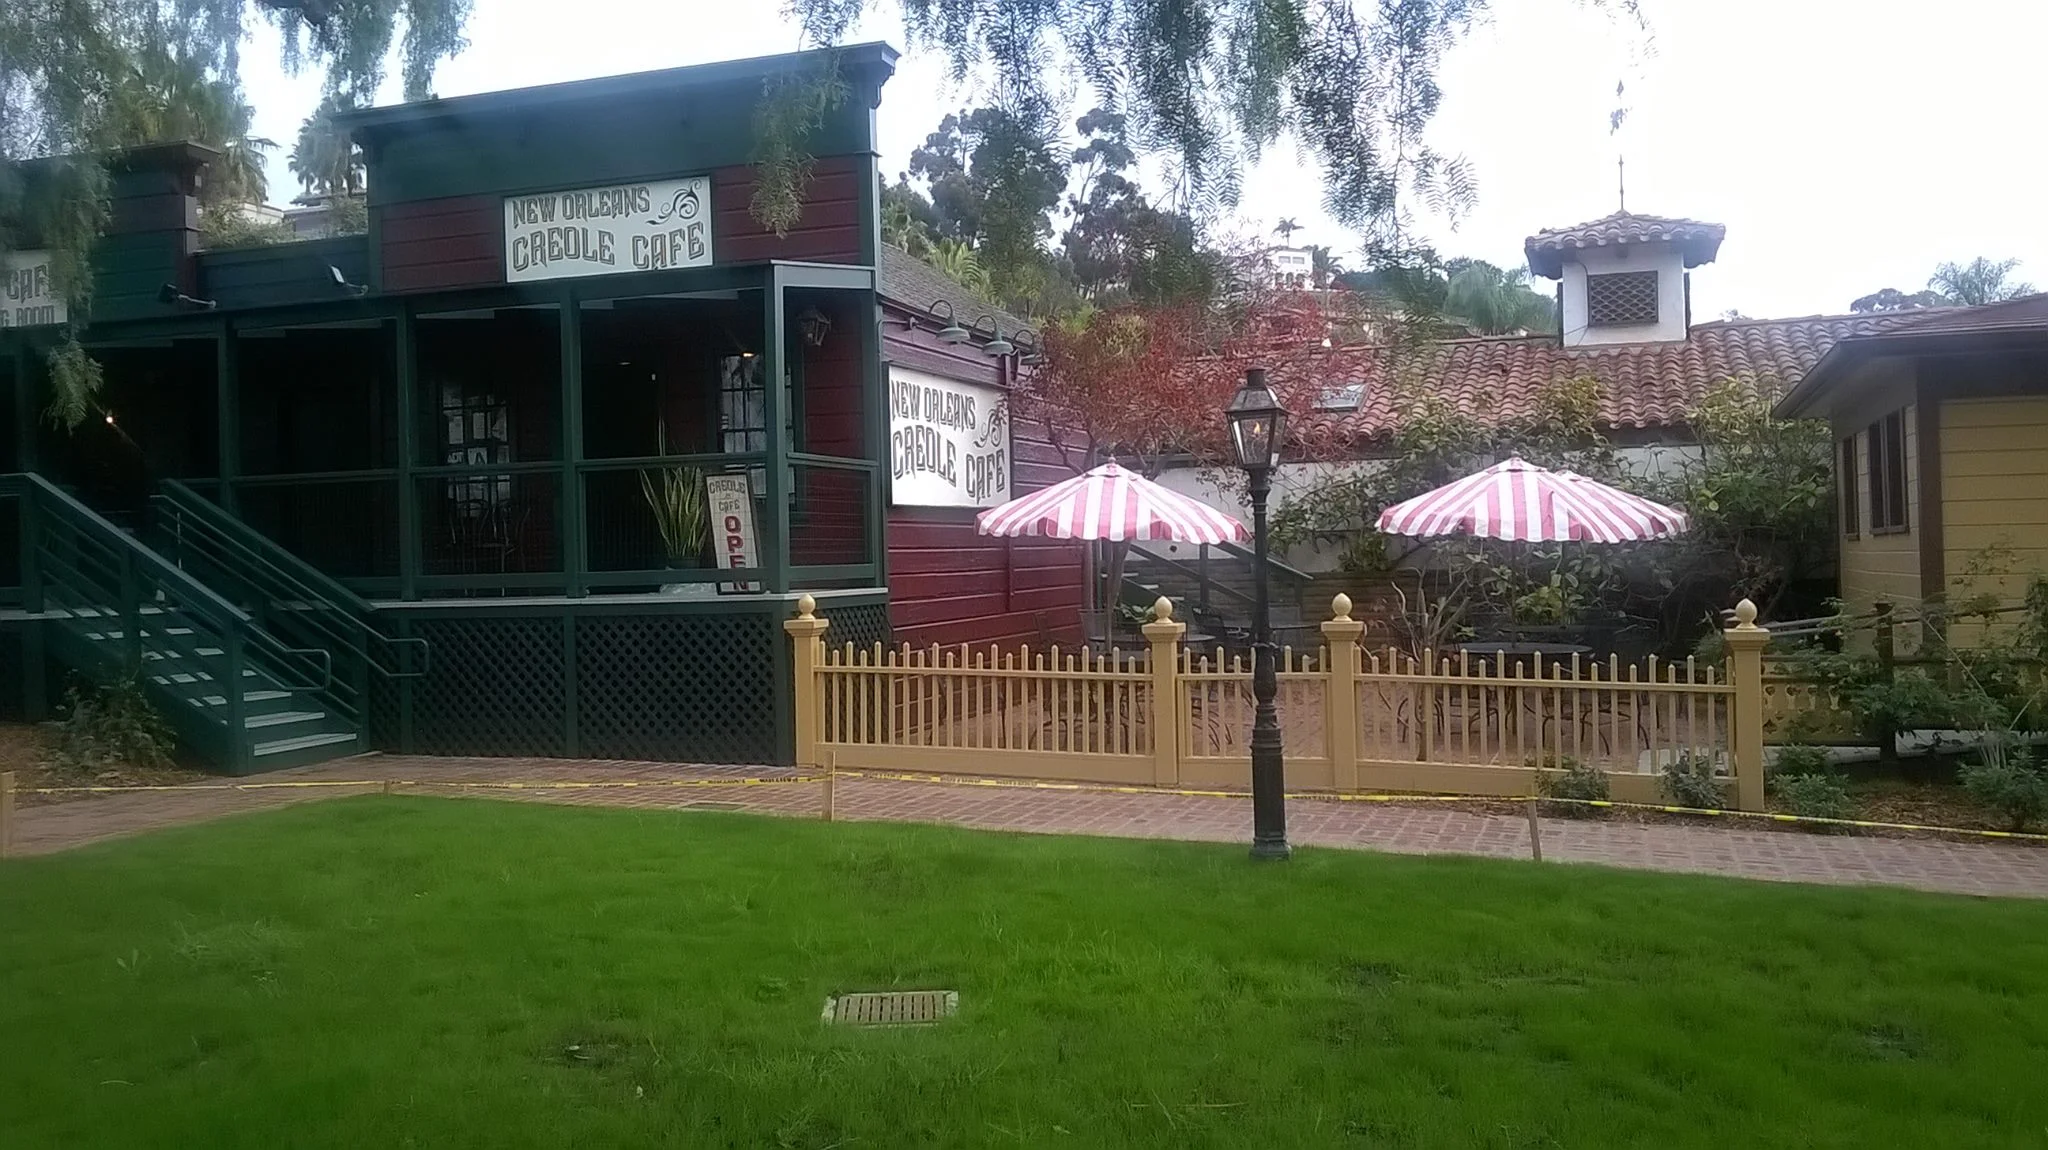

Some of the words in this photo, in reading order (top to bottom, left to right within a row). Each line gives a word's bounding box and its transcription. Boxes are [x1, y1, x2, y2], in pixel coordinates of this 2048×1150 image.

[512, 196, 557, 229] NEW
[562, 186, 650, 222] ORLEANS
[512, 226, 615, 272] CREOLE
[631, 221, 705, 270] CAFE
[891, 379, 921, 422] NEW
[924, 387, 976, 433] ORLEANS
[709, 480, 746, 494] CREOLE
[892, 425, 957, 488] CREOLE
[965, 448, 1006, 505] CAFE
